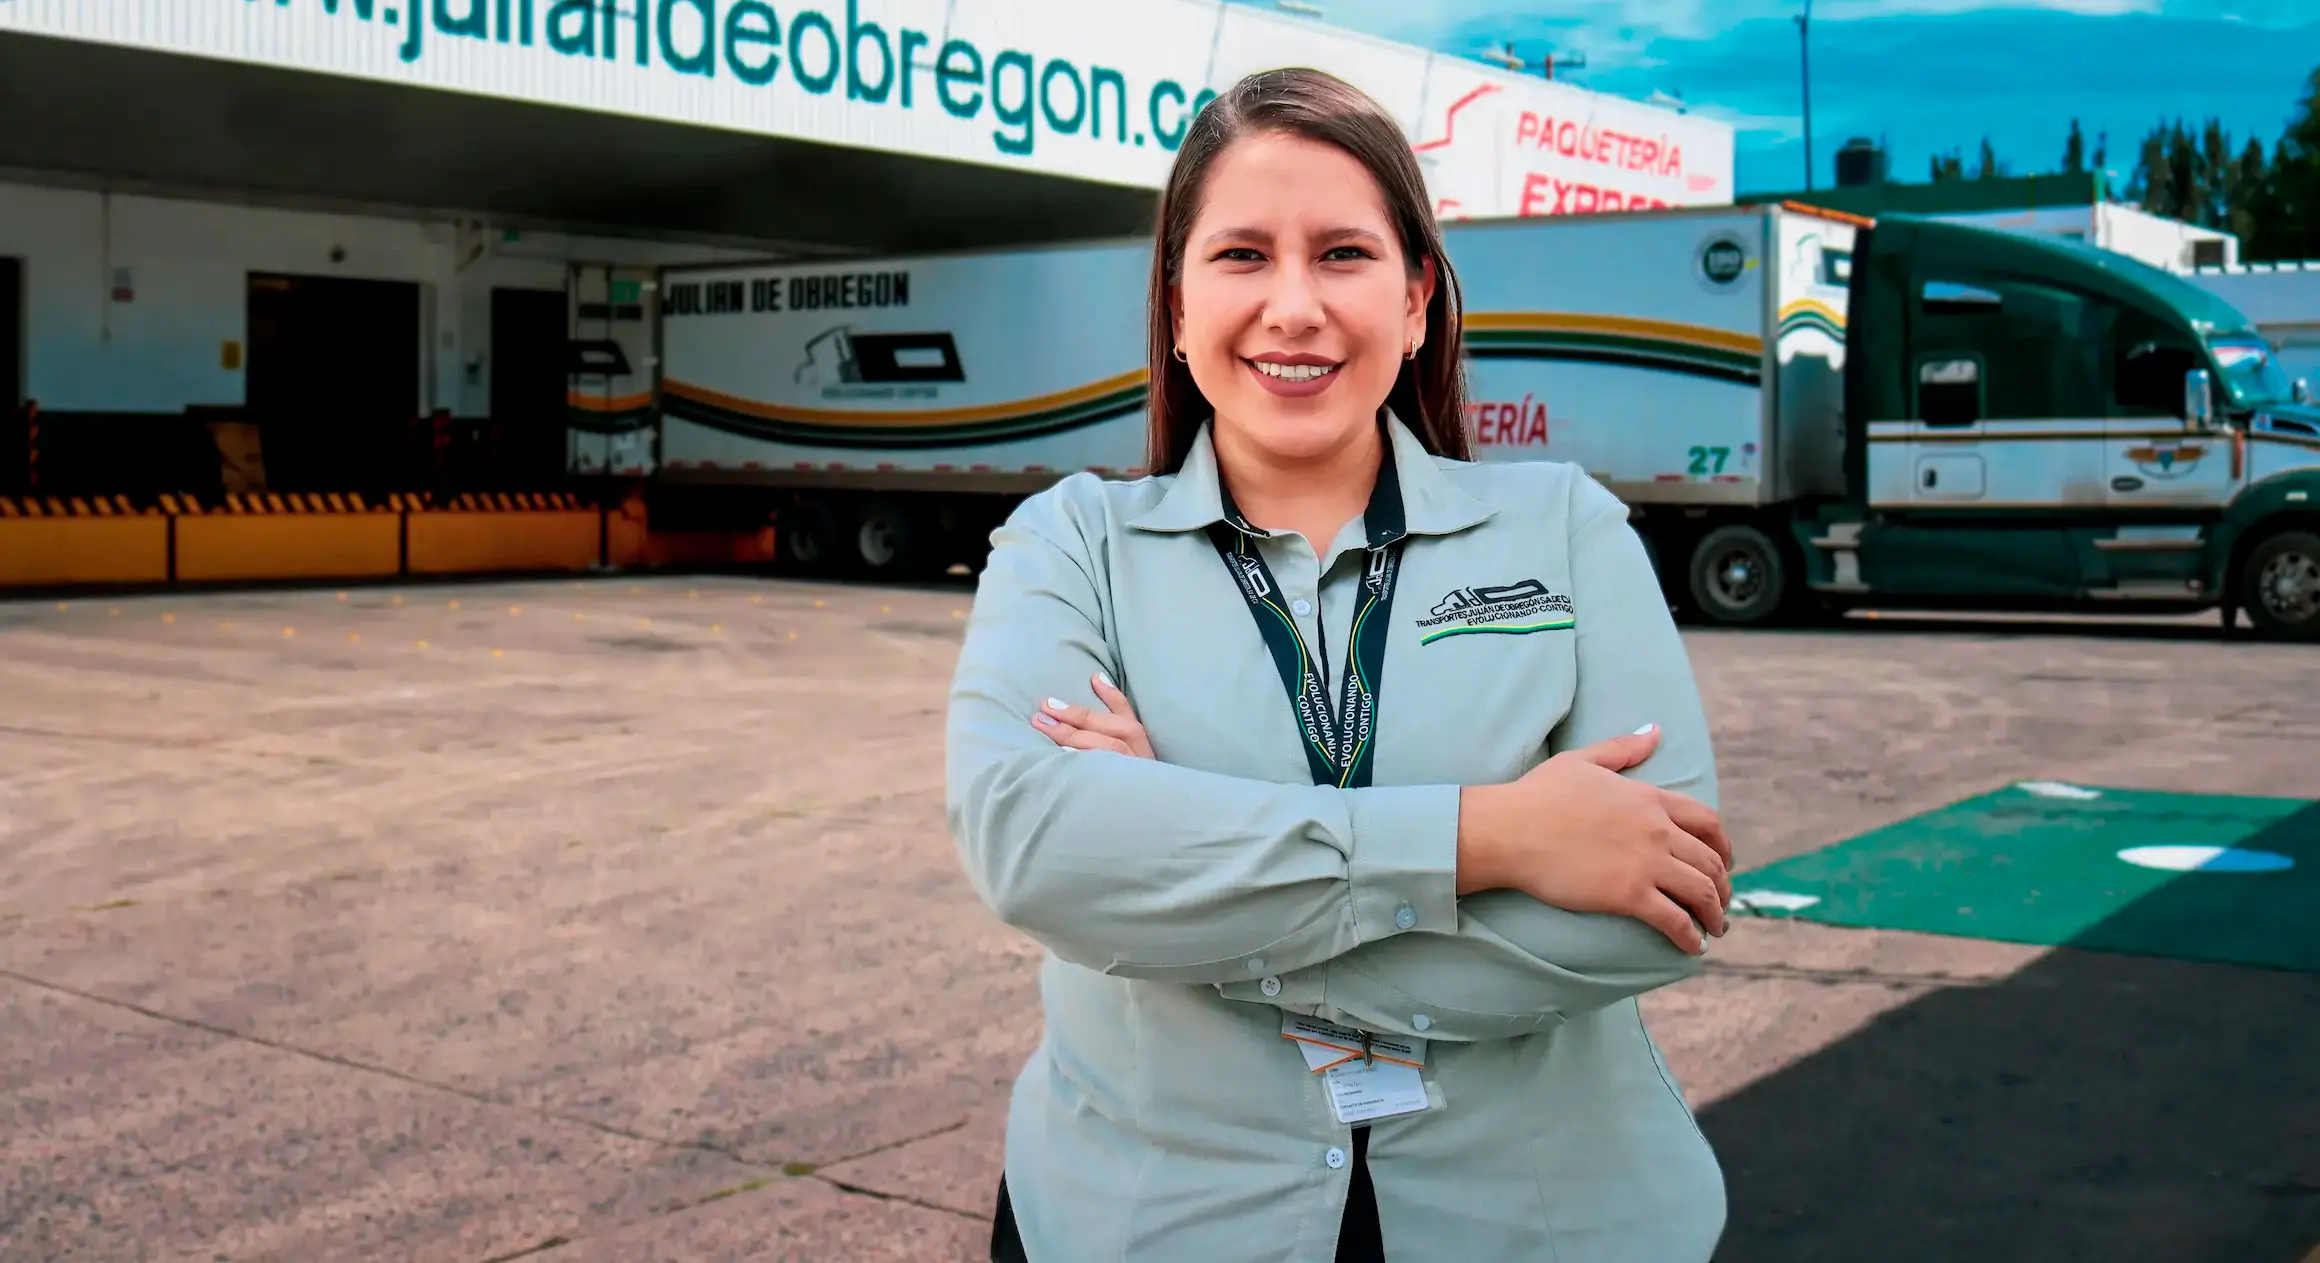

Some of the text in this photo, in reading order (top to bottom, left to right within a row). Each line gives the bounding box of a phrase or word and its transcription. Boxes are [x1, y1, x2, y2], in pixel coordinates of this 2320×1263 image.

[1516, 110, 1682, 177] PAQUETERÍA
[662, 280, 744, 316] JULIAN
[752, 277, 782, 312] DE
[789, 271, 910, 310] OBREGON
[1688, 446, 1730, 474] 27
[1416, 610, 1467, 627] TRANSPORTES
[1467, 604, 1574, 626] EVOLUCIONANDO CONTIGO
[1297, 695, 1319, 742] CONTIGO
[1341, 674, 1359, 767] EVOLUCIONANDO
[1358, 692, 1372, 741] CONTIGO
